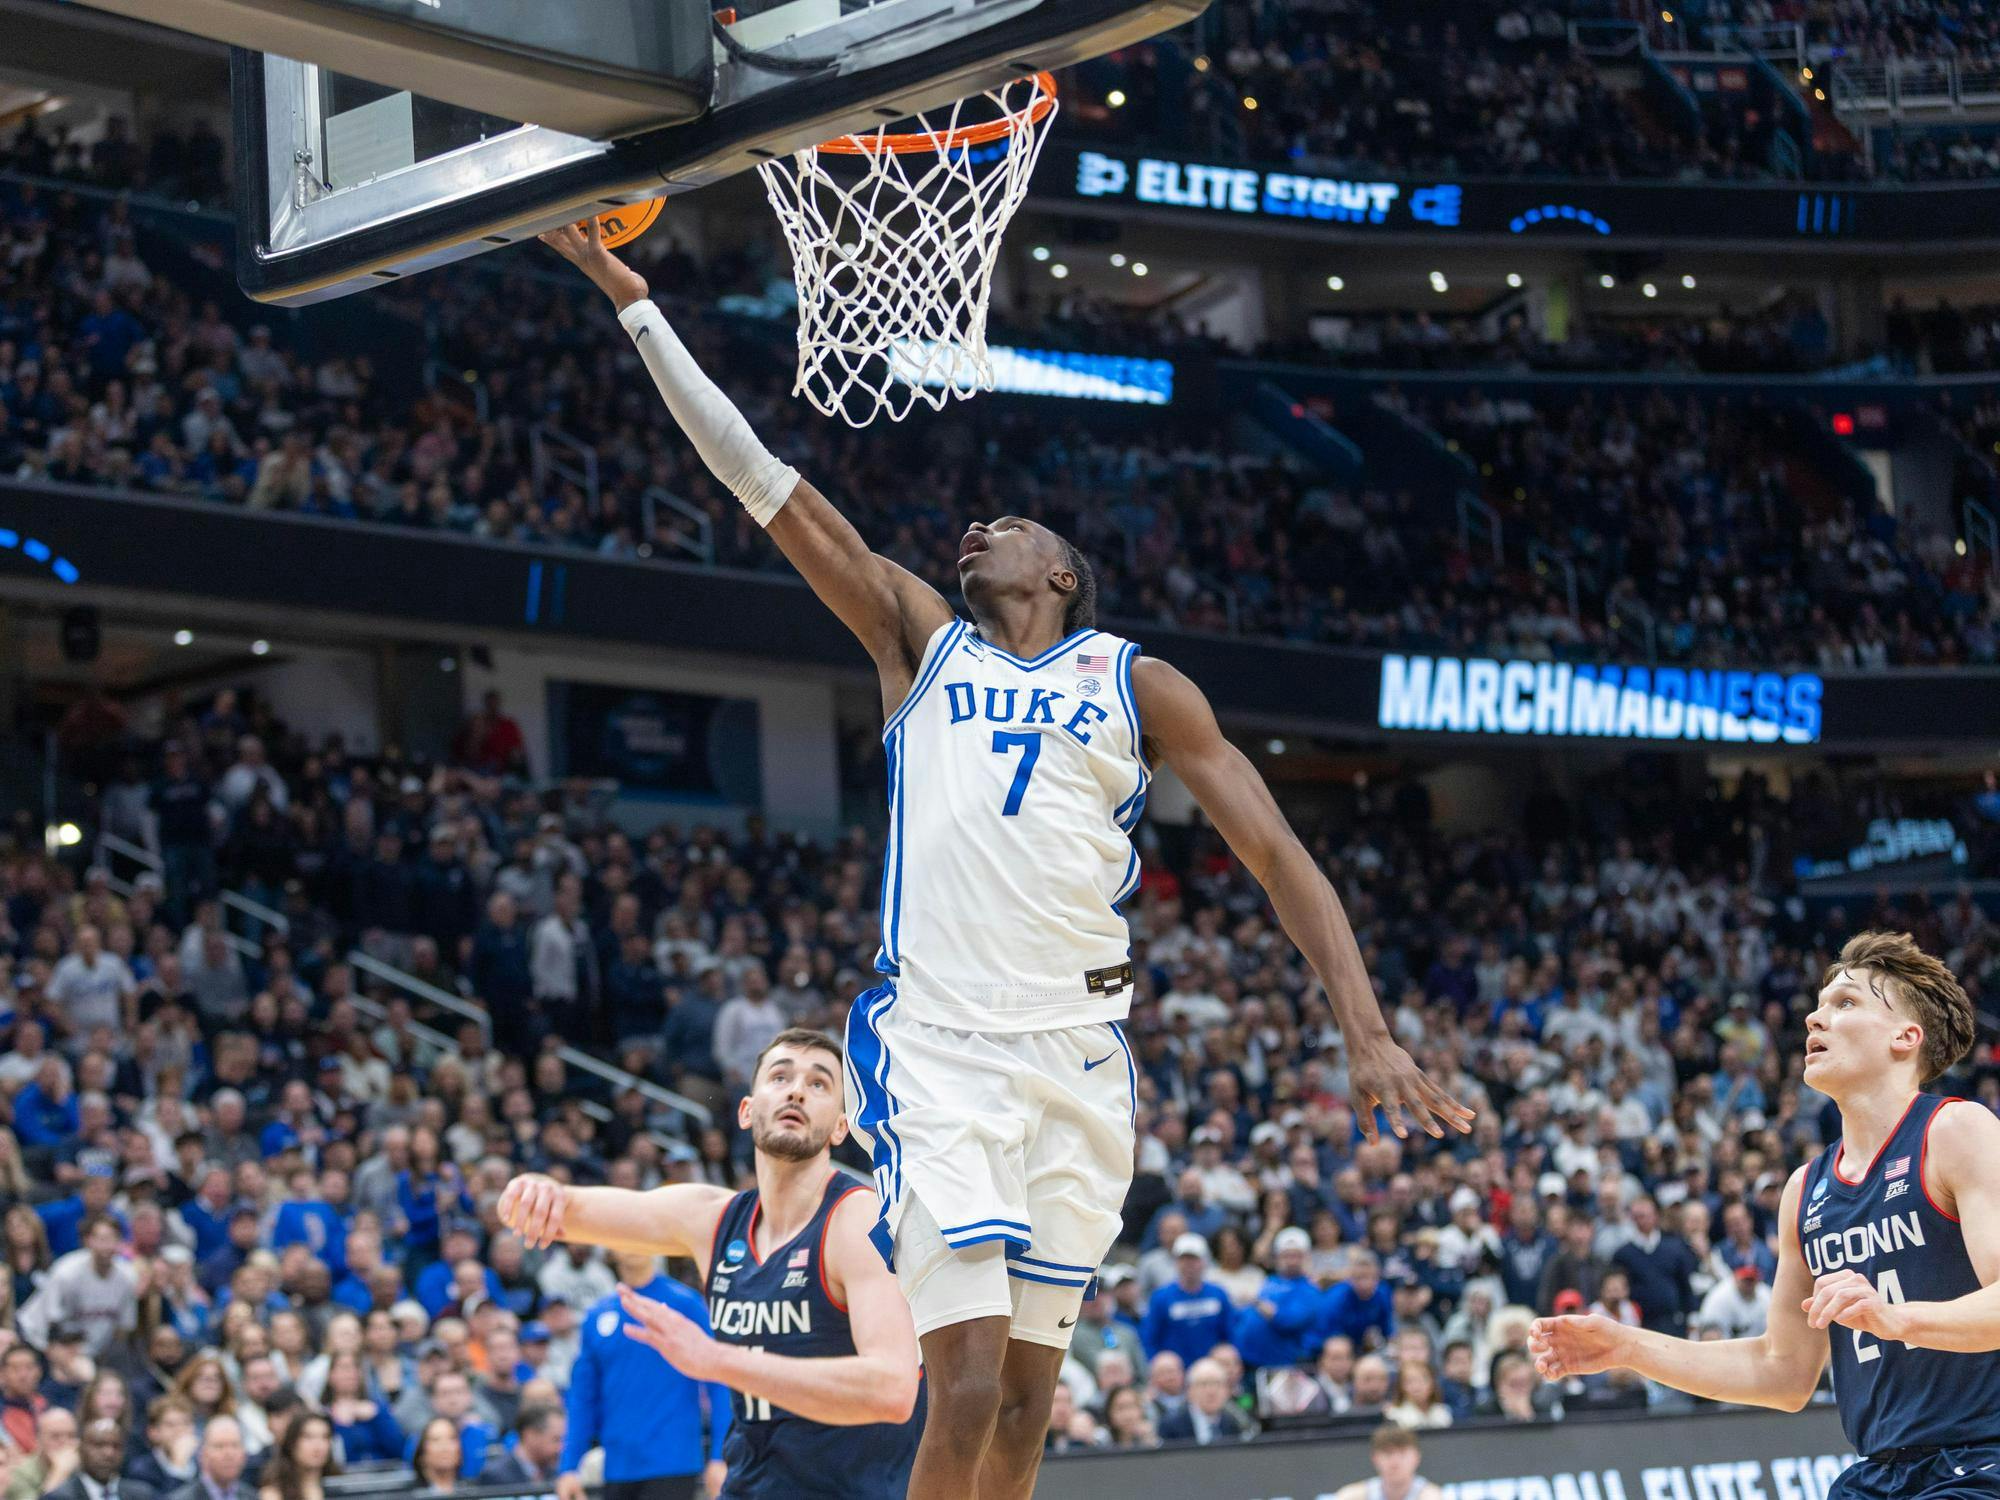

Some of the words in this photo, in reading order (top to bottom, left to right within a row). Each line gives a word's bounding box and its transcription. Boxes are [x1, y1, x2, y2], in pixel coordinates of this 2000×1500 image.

[1137, 158, 1258, 213] ELITE
[1262, 173, 1398, 225] EIGHT
[944, 681, 1109, 746] DUKE
[991, 730, 1042, 816] 7
[1804, 1210, 1926, 1276] UCONN
[709, 1296, 812, 1336] UCONN
